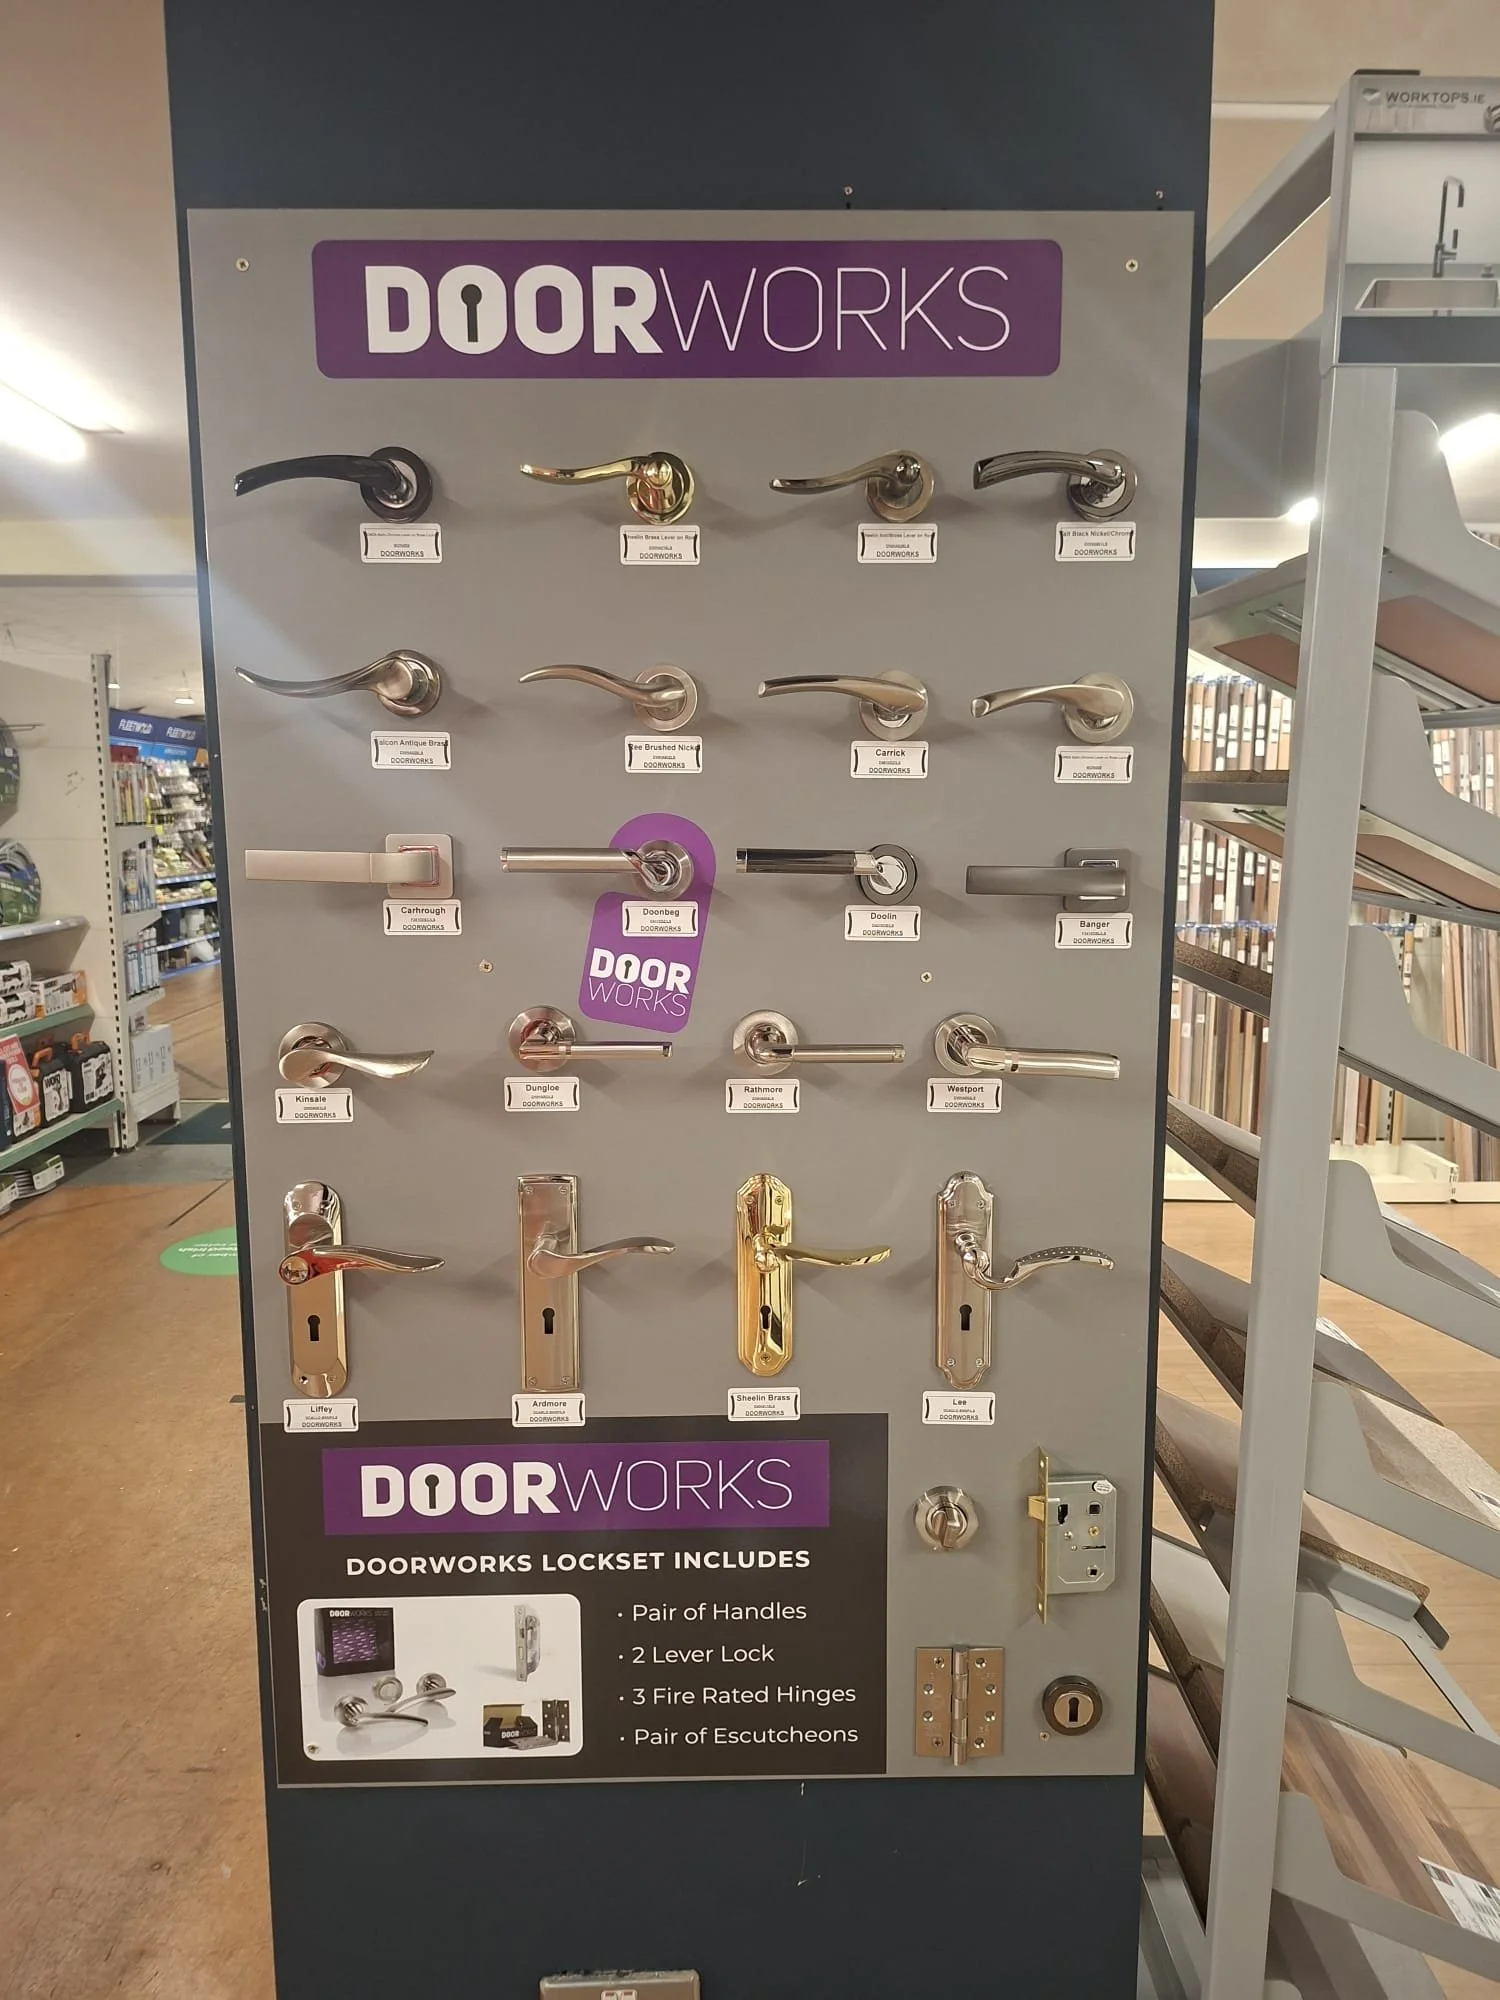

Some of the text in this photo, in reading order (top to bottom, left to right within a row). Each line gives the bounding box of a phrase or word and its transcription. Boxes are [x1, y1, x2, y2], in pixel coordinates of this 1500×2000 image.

[364, 263, 1010, 355] DOORWORKS
[380, 550, 425, 558] DOORWORKS
[639, 552, 683, 560] DOORWORKS
[399, 739, 427, 748] Antique
[644, 743, 676, 751] Brushed
[875, 748, 906, 757] Carrick
[390, 757, 434, 765] DOORWORKS
[643, 761, 685, 769] DOORWORKS
[1072, 771, 1115, 779] DOORWORKS
[400, 906, 446, 916] Carhrough
[642, 907, 680, 917] Doonbeg
[870, 912, 897, 920] Doolin
[402, 923, 445, 931] DOORWORKS
[1079, 920, 1110, 930] Banger
[862, 929, 904, 937] DOORWORKS
[589, 947, 692, 995] DOOR
[588, 977, 688, 1017] WORKS
[525, 1083, 560, 1093] Dungloe
[744, 1085, 783, 1093] Rathmore
[947, 1085, 985, 1094] Westport
[295, 1095, 327, 1103] Kinsale
[522, 1100, 564, 1108] DOORWORKS
[944, 1101, 985, 1109] DOORWORKS
[294, 1111, 336, 1119] DOORWORKS
[736, 1394, 791, 1402] Sheelin Brass
[952, 1398, 967, 1406] Lee
[531, 1400, 567, 1408] Ardmore
[310, 1405, 333, 1414] Liffey
[360, 1457, 793, 1518] DOORWORKS
[346, 1549, 811, 1576] DOORWORKS LOCKSET INCLUDES
[633, 1602, 807, 1622] Pair of Handles
[632, 1643, 775, 1664] 2 Lever Lock
[632, 1685, 856, 1706] 3 Fire Rated Hinges
[635, 1726, 858, 1745] Pair of Escutcheons
